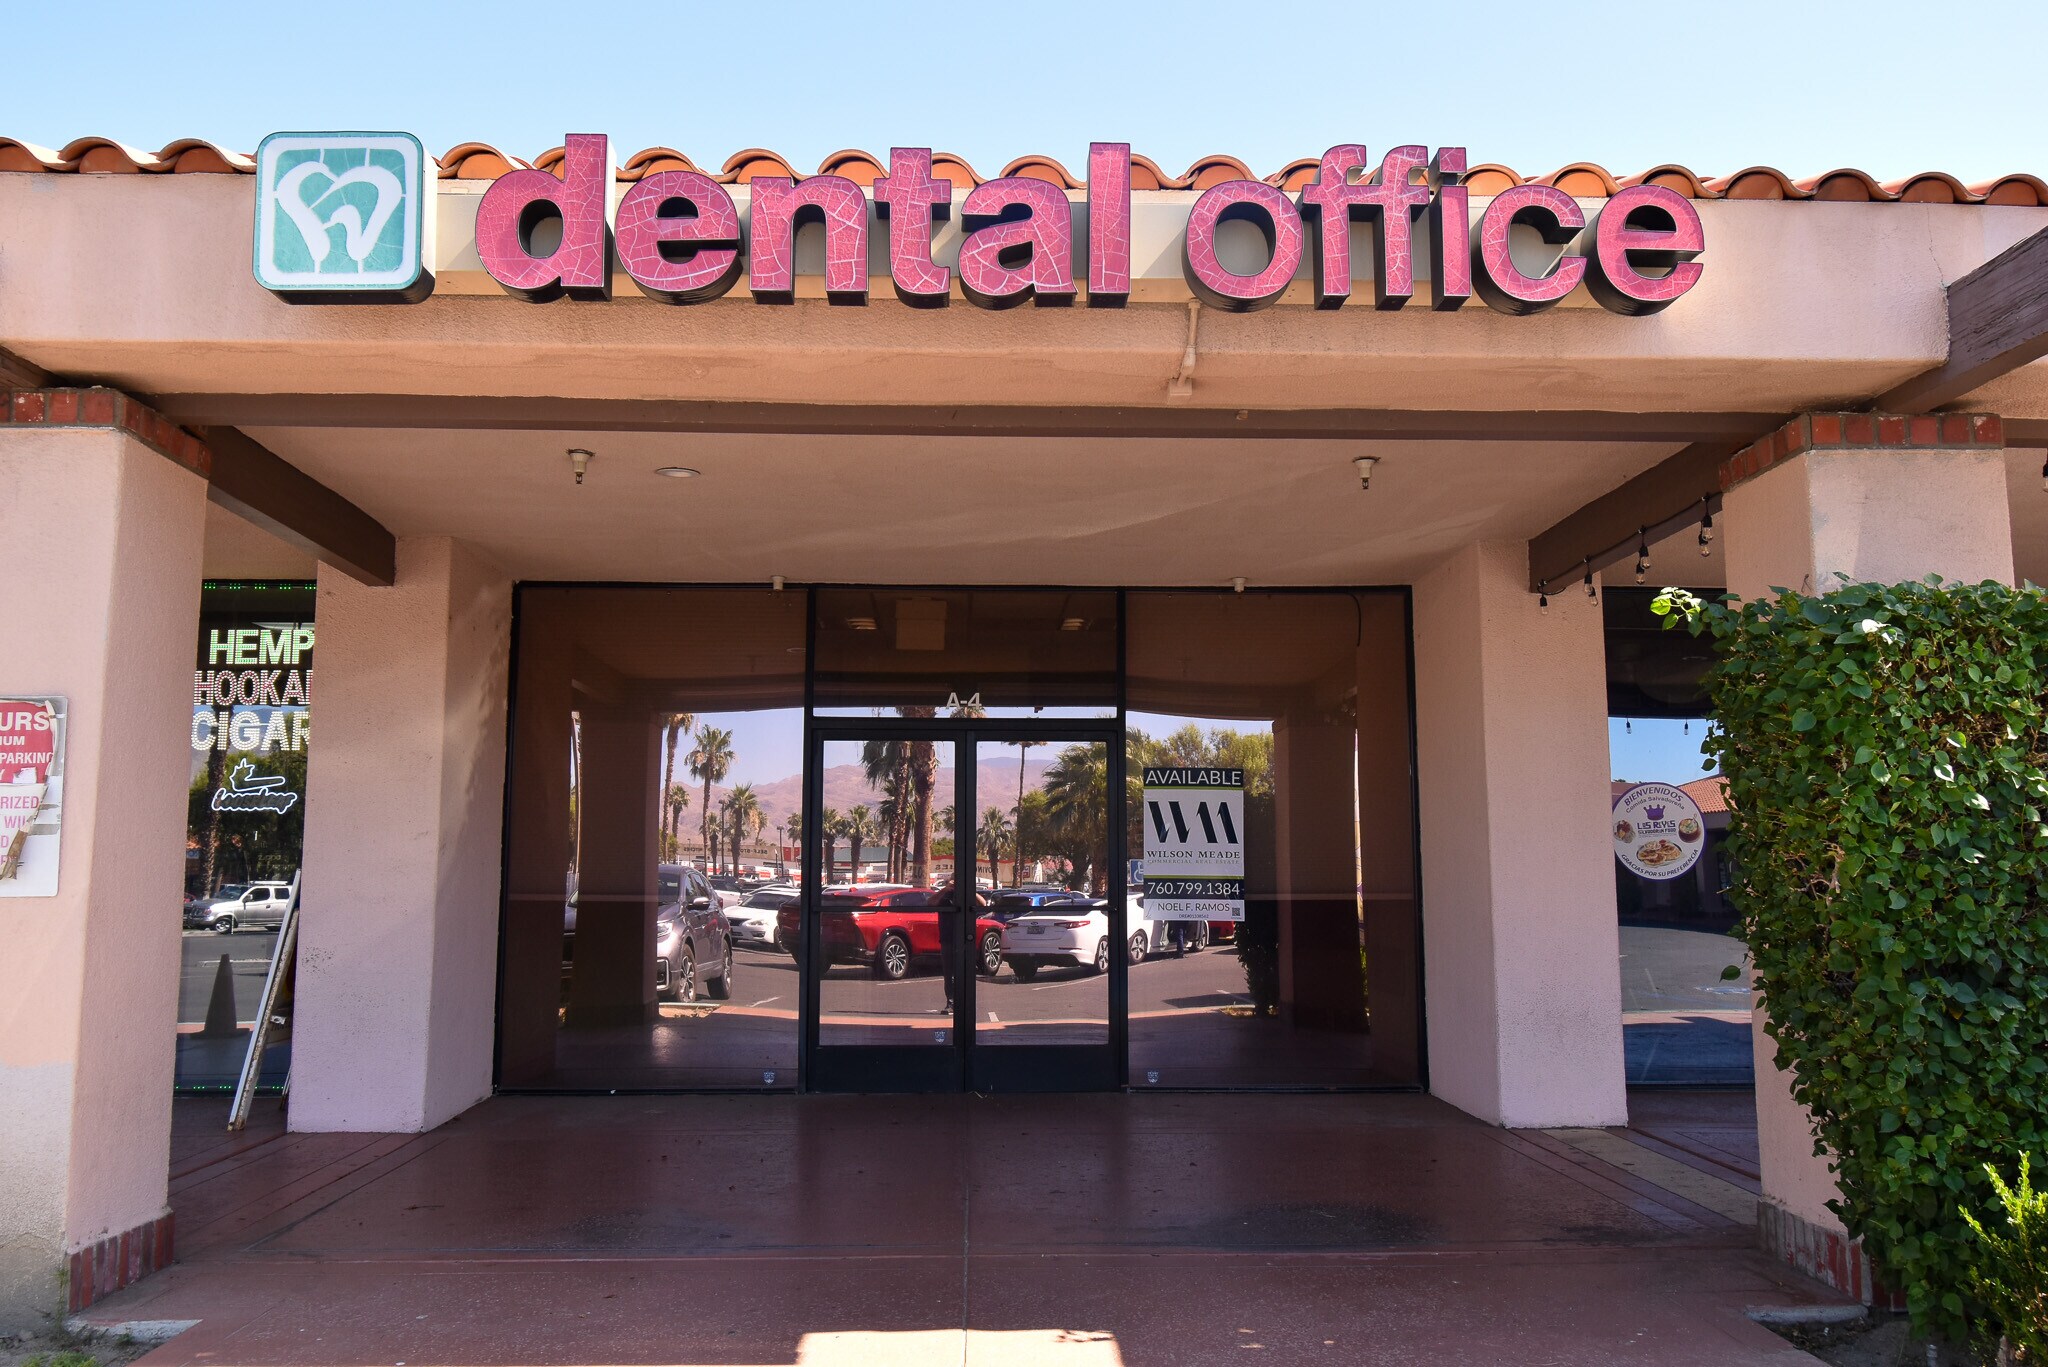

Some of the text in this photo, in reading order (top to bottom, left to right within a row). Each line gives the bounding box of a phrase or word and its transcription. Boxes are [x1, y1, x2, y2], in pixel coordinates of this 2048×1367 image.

[475, 133, 1705, 306] dental office
[209, 629, 315, 664] HEMP
[945, 692, 982, 710] A-4
[1145, 769, 1242, 786] AVAILABLE
[1624, 787, 1684, 806] BIENVENIDOS
[1626, 799, 1647, 813] Comida
[1147, 850, 1241, 859] WILSON MEADE
[1621, 854, 1644, 874] GRACIAS
[1644, 869, 1657, 877] POR
[1667, 849, 1699, 876] PREFERENCIA
[1147, 882, 1240, 896] 760.799.1384
[1158, 902, 1230, 912] NOEL F. RAMOS
